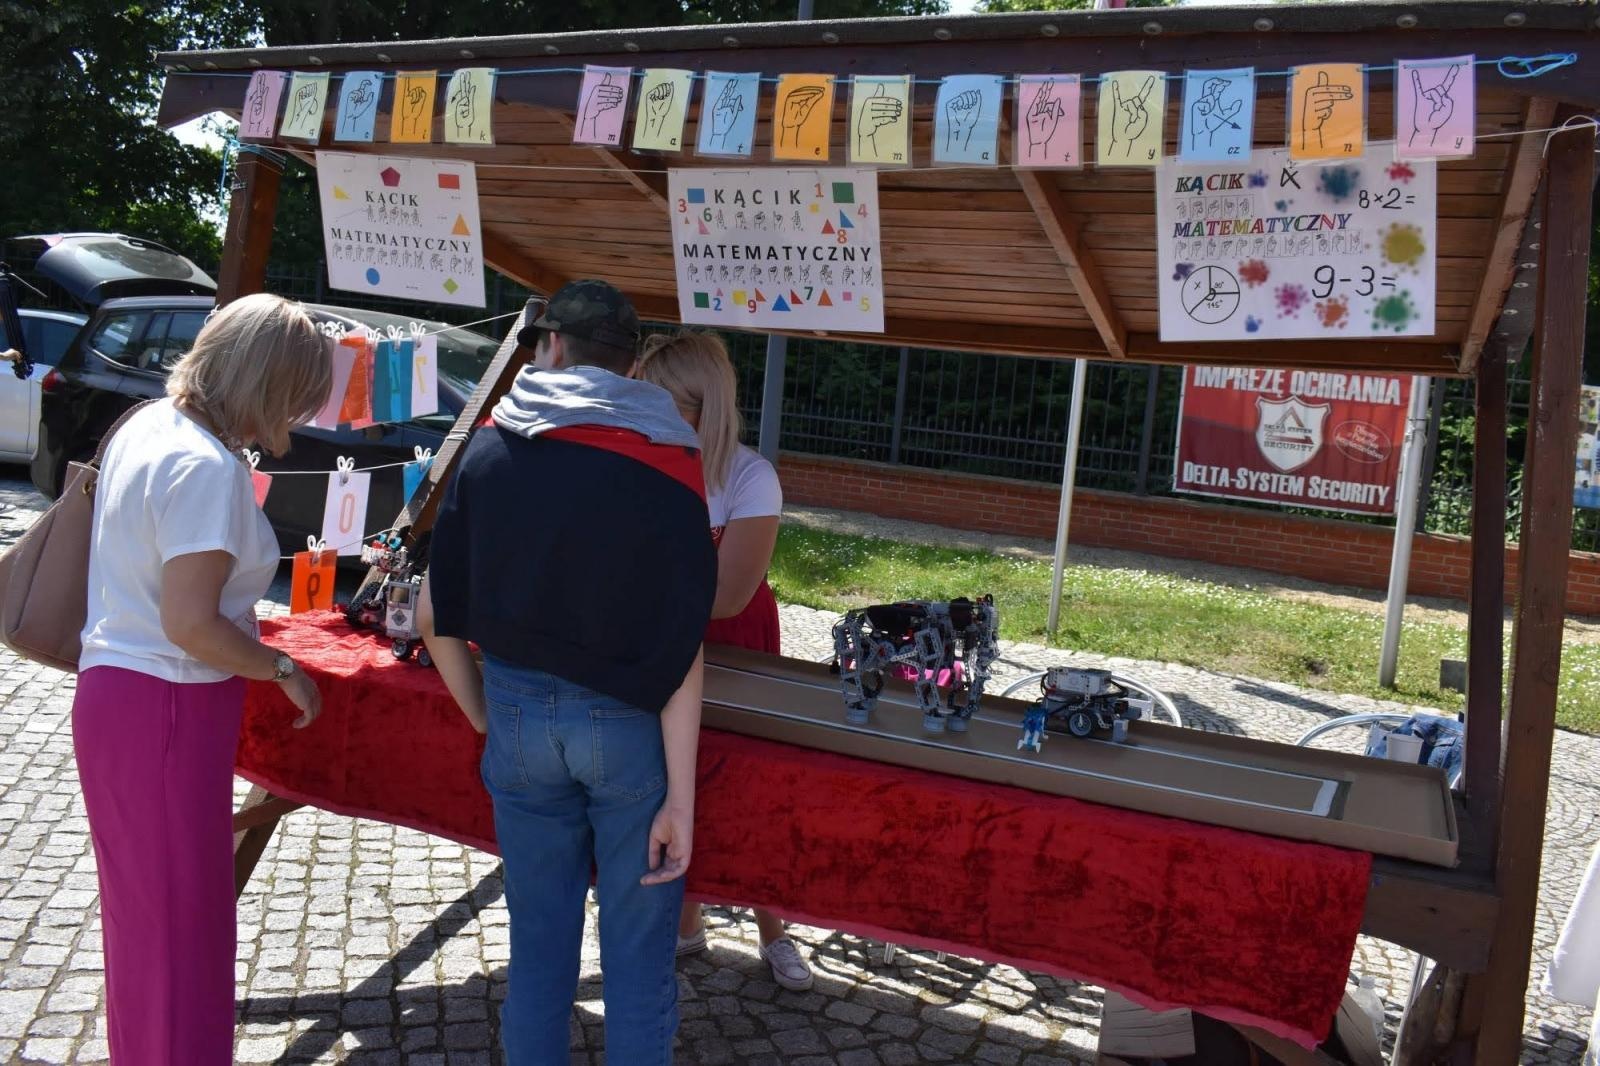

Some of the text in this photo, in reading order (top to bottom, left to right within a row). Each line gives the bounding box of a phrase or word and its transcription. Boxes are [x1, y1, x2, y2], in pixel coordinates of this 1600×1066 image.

[479, 130, 486, 141] k
[607, 133, 615, 142] m
[669, 137, 677, 146] a
[1454, 137, 1464, 149] y
[737, 143, 744, 153] t
[814, 146, 821, 155] e
[1147, 148, 1156, 160] y
[1227, 146, 1240, 155] cz
[1343, 143, 1352, 152] n
[892, 151, 902, 161] m
[981, 151, 989, 161] a
[1064, 152, 1071, 162] t
[815, 183, 824, 198] 1
[1175, 172, 1245, 194] KĄCIK
[364, 190, 419, 208] KĄCIK
[678, 198, 688, 213] 3
[713, 188, 802, 209] KĄCIK
[703, 207, 713, 223] 6
[857, 203, 868, 218] 4
[1173, 213, 1352, 238] MATEMATYCZNY
[330, 227, 472, 253] MATEMATYCZNY
[836, 229, 848, 244] 8
[683, 243, 871, 261] MATEMATYCZNY
[804, 286, 814, 301] 7
[712, 297, 723, 311] 2
[747, 299, 757, 314] 9
[861, 296, 871, 311] 5
[1193, 366, 1401, 405] IMPREZĘ OCHRANIA
[1263, 441, 1314, 451] SECURITY
[1309, 475, 1390, 506] SECURITY
